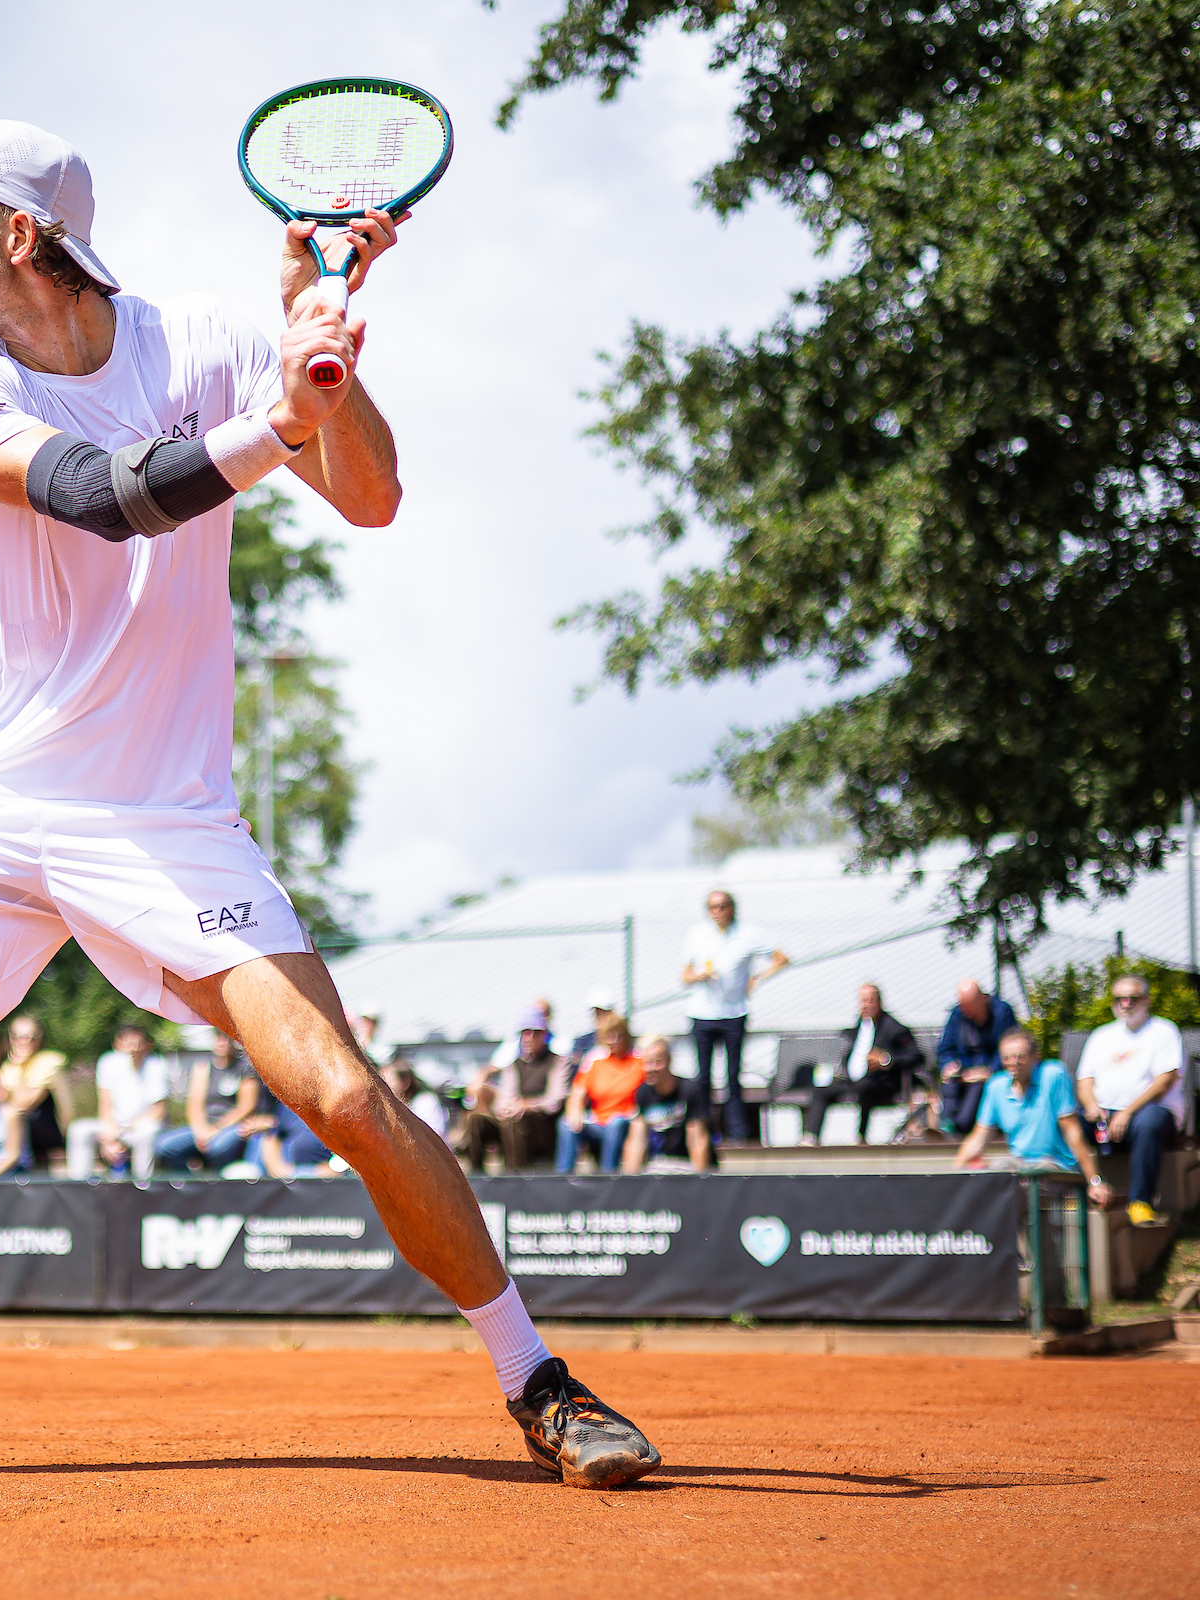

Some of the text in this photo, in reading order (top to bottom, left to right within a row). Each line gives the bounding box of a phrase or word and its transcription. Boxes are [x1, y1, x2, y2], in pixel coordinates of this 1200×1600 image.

[162, 410, 199, 440] A7
[197, 901, 253, 933] EA7
[800, 1230, 832, 1255] Du
[873, 1229, 927, 1255] nicht
